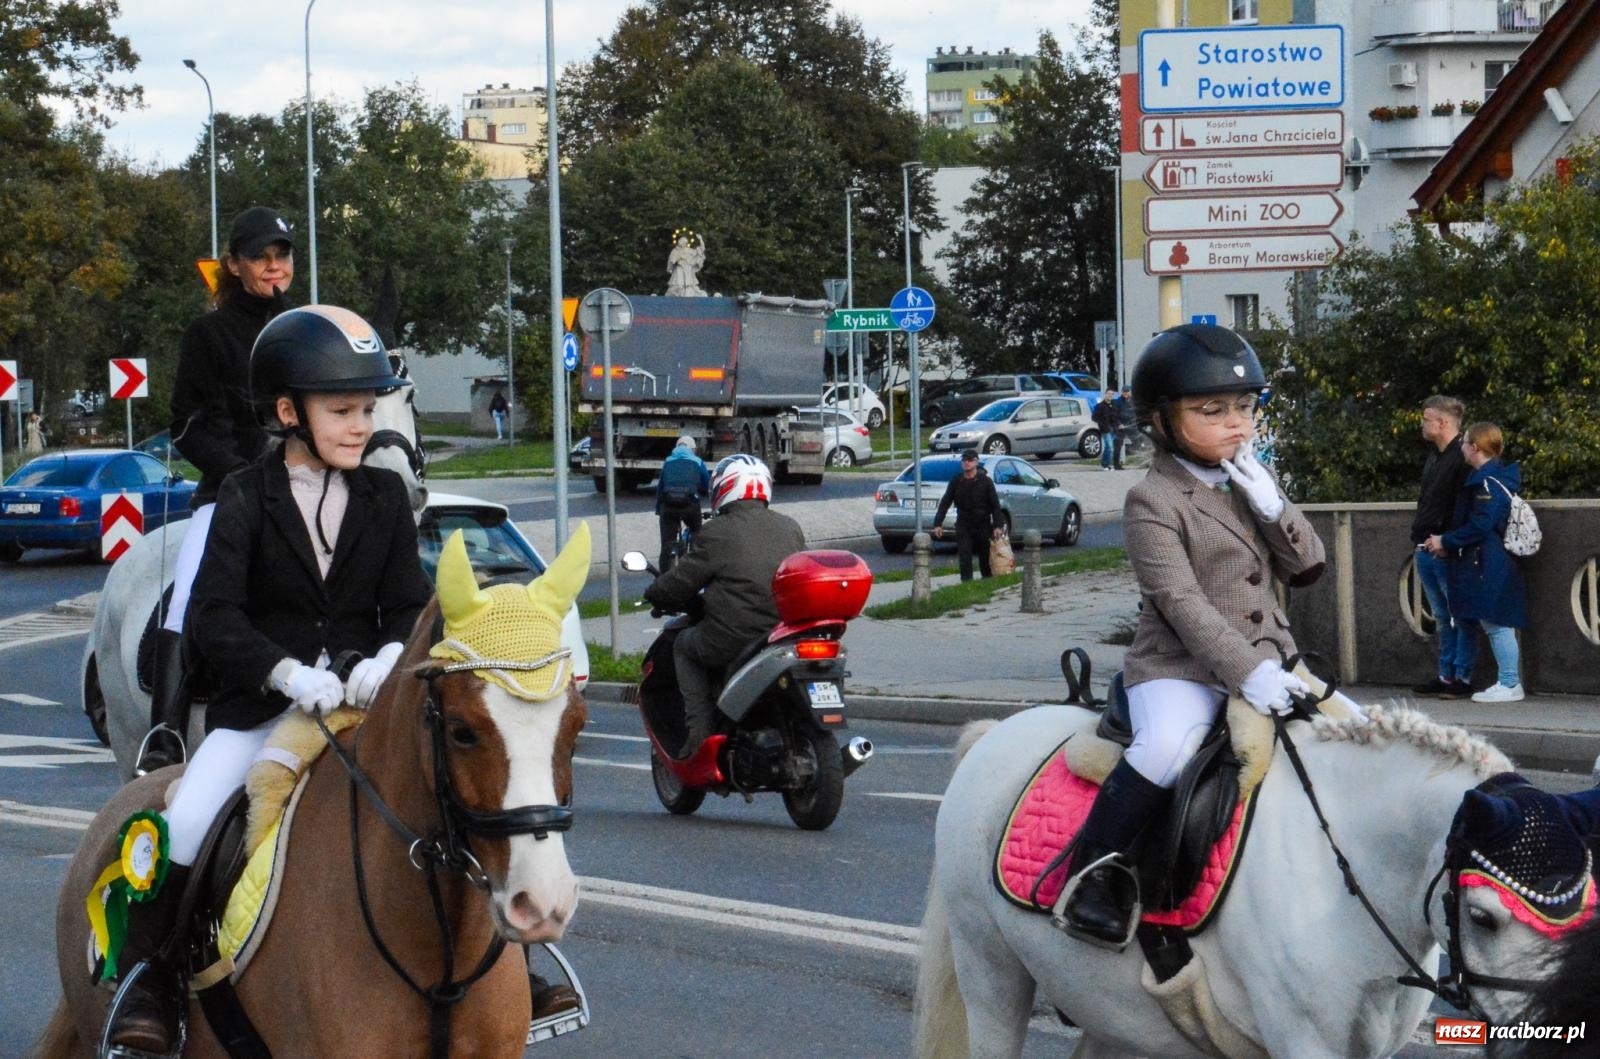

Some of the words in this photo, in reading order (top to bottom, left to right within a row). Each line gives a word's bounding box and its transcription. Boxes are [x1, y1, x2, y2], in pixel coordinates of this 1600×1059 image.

[1198, 41, 1323, 65] Starostwo
[1198, 76, 1331, 100] Powiatowe
[1263, 128, 1336, 142] Chrzciciela
[1206, 161, 1233, 169] Zamek
[1206, 170, 1273, 185] Piastowski
[1208, 204, 1247, 222] Mini
[1259, 202, 1301, 220] ZOO
[1208, 241, 1252, 249] Arboretum
[1208, 252, 1249, 267] Bramy
[843, 314, 889, 330] Rybnik
